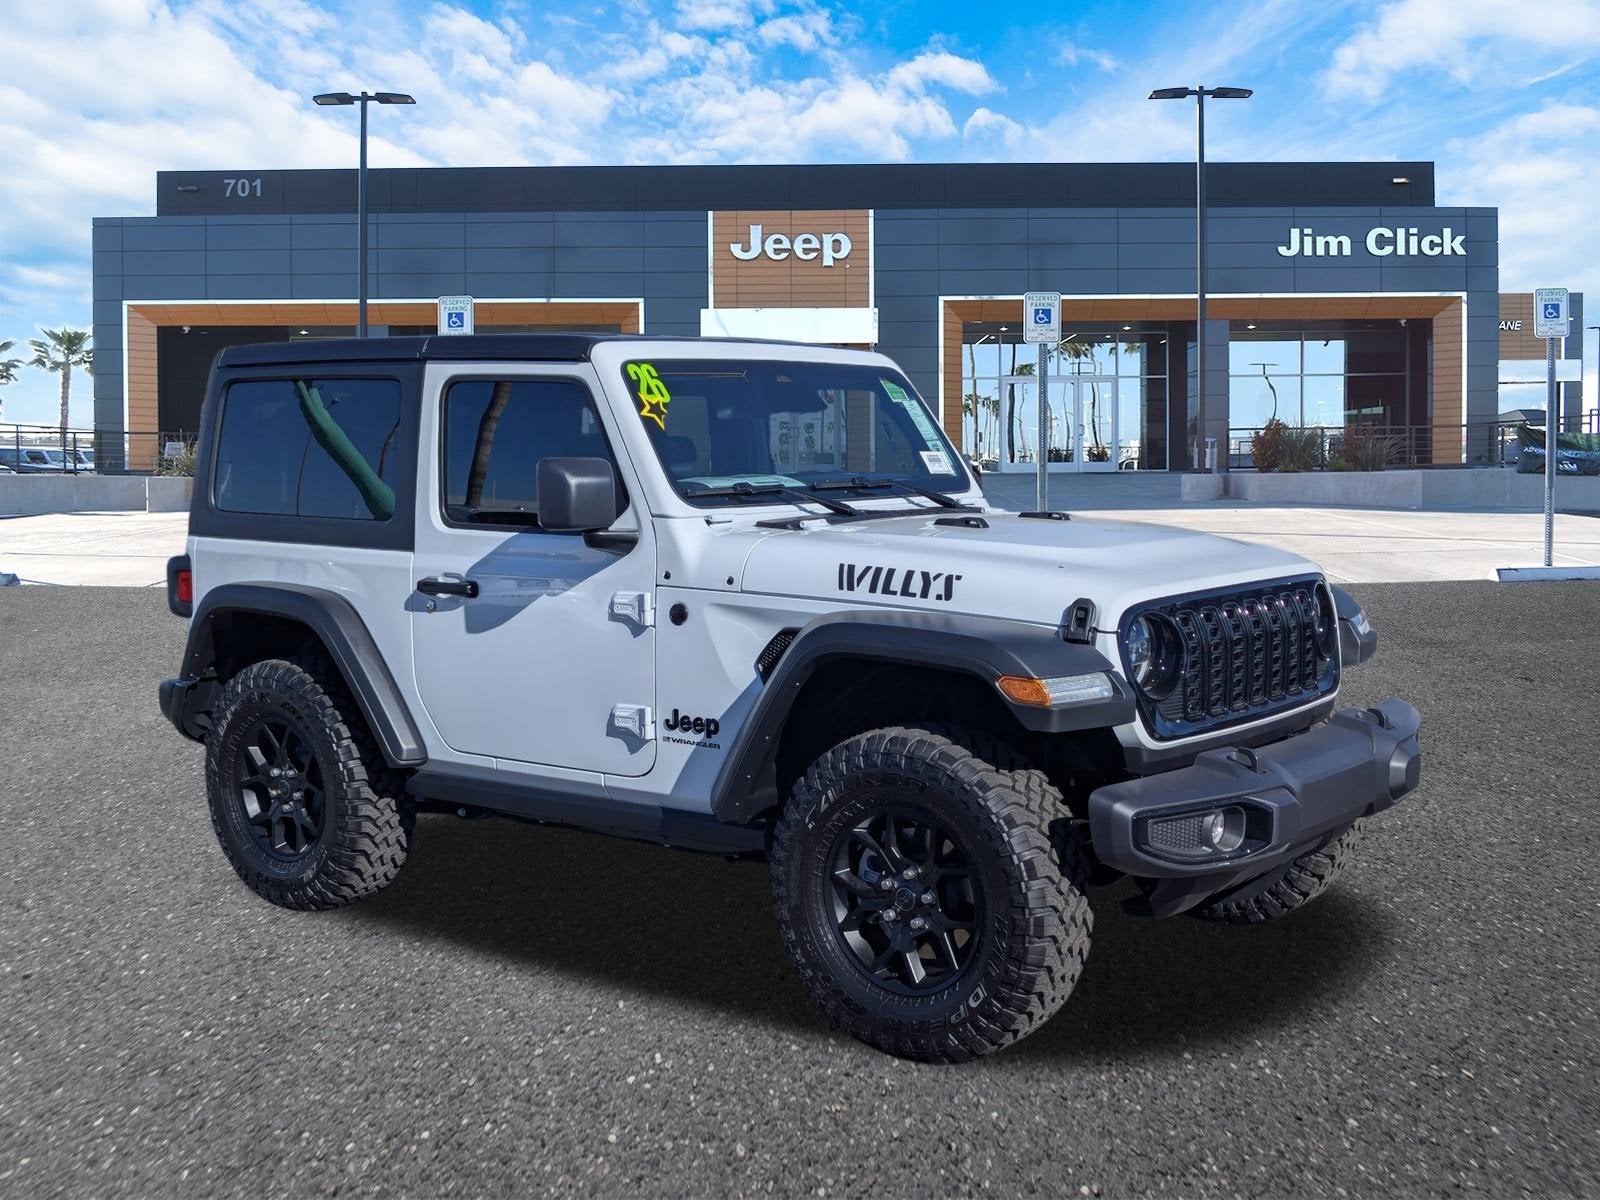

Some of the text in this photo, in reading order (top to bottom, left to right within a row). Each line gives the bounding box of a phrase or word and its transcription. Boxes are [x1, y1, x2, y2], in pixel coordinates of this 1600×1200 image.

[223, 178, 262, 197] 701
[730, 224, 852, 267] Jeep
[1277, 227, 1467, 257] Jim Click
[1498, 320, 1522, 331] ANE
[626, 363, 671, 403] 26
[838, 563, 963, 602] WILLYS
[664, 708, 720, 739] Jeep
[671, 737, 720, 749] WRANGLER
